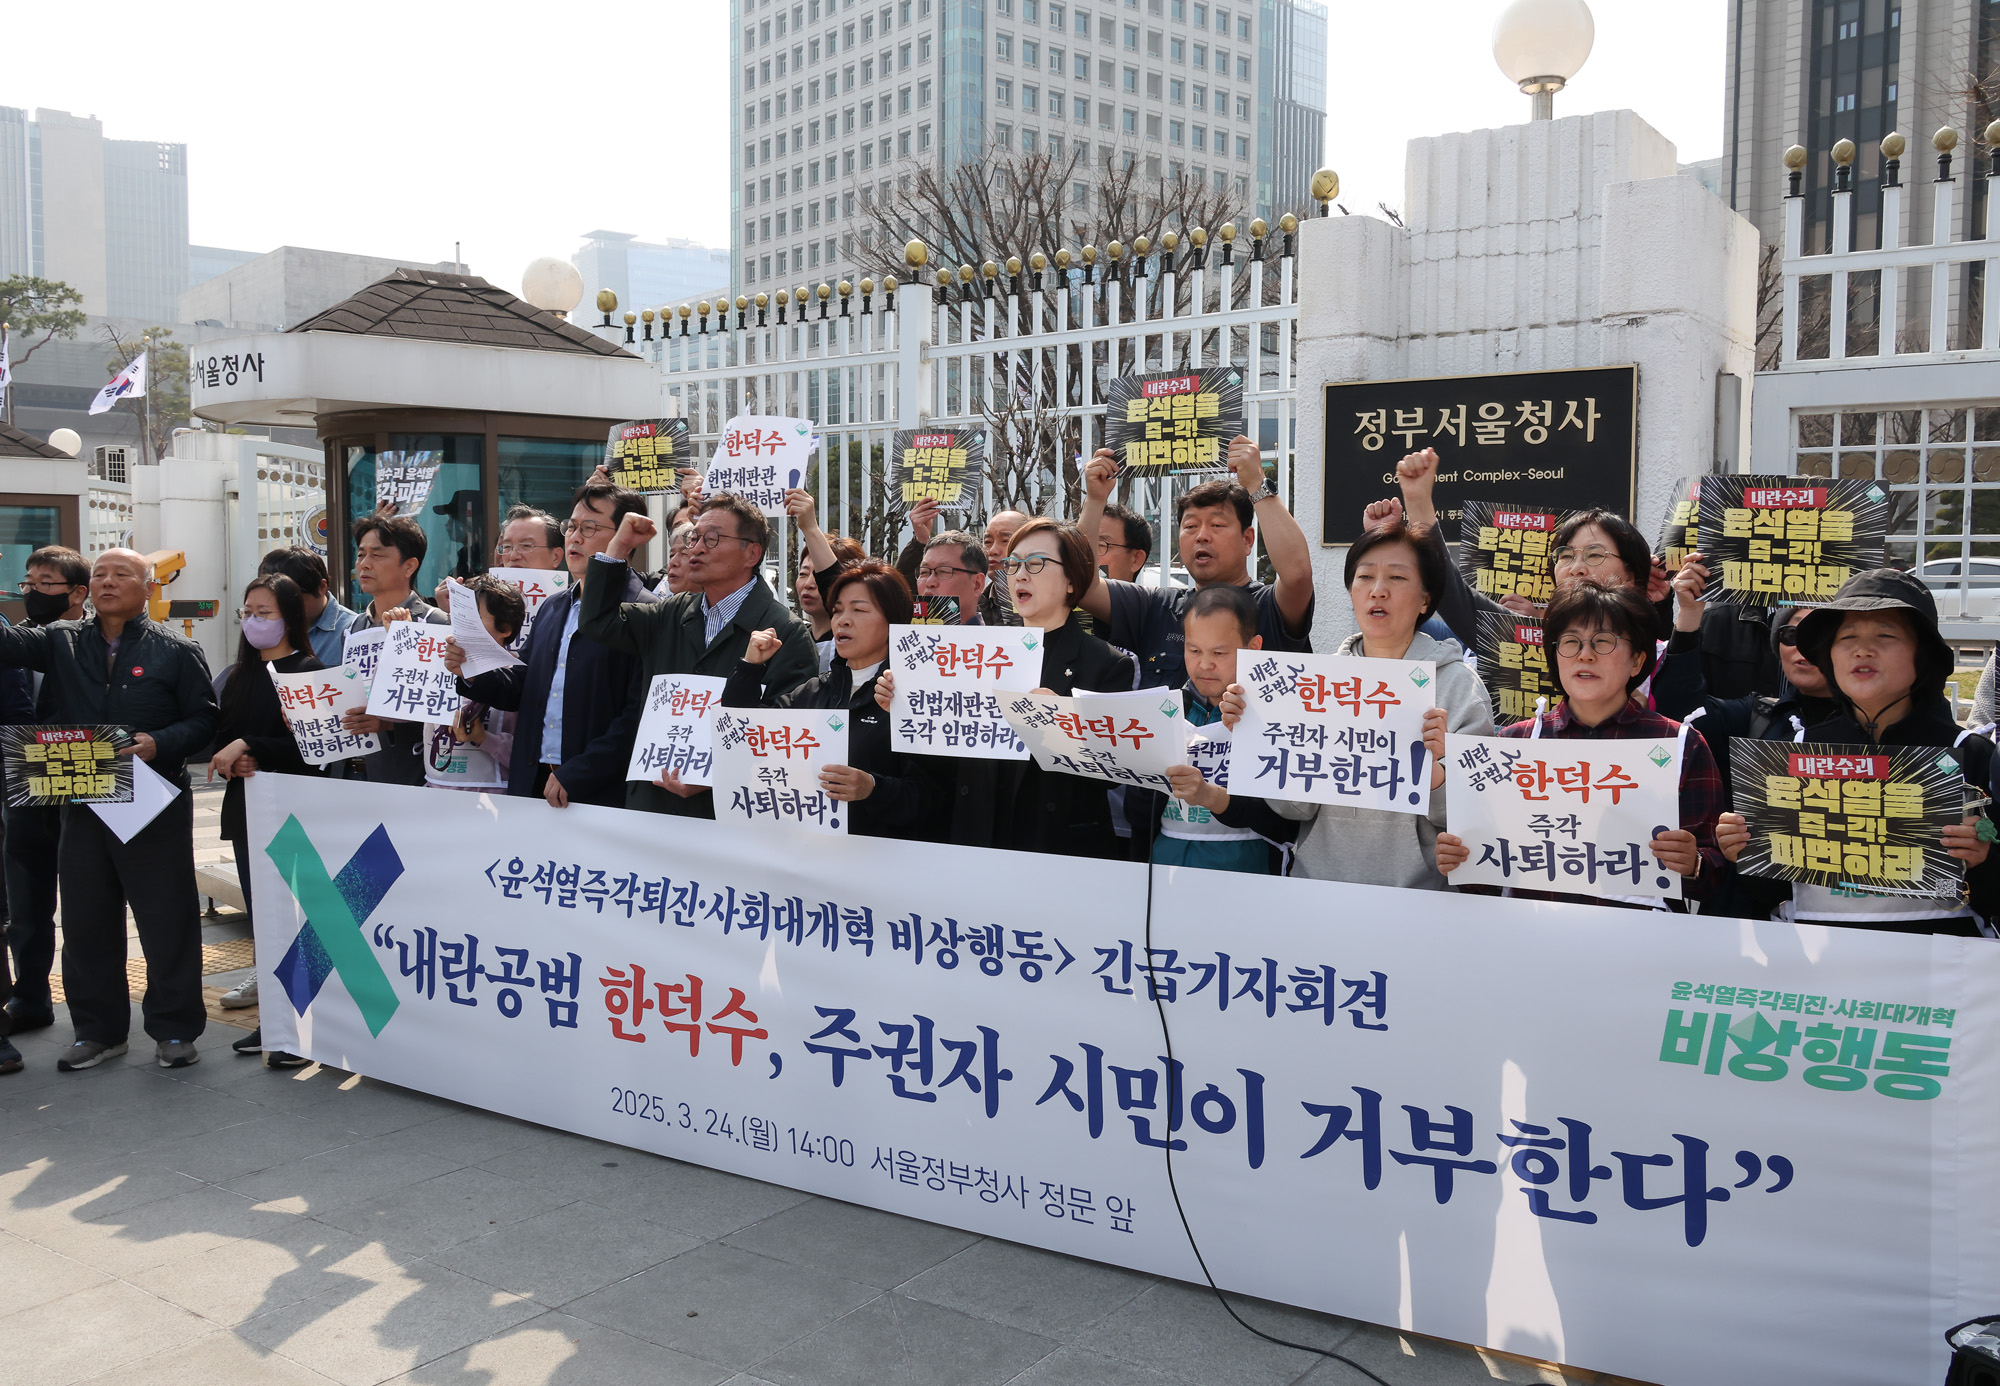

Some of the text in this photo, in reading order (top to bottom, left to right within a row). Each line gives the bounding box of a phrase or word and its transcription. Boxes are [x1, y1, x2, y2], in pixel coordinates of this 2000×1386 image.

[191, 353, 265, 389] 서울청사
[1147, 378, 1191, 395] 내란수괴
[1126, 393, 1220, 423] 윤석열을
[1353, 397, 1601, 451] 정부서울청사
[612, 436, 673, 458] 윤석열을
[726, 428, 787, 457] 한덕수
[1125, 437, 1221, 467] 파면하라
[902, 447, 968, 468] 윤석열을
[612, 468, 676, 489] 파면하라
[708, 465, 777, 489] 헌법재판관
[1463, 467, 1564, 483] Complex-Seoul
[902, 481, 962, 502] 파면하라
[1751, 489, 1814, 506] 내란수괴
[1499, 514, 1545, 528] 내란수괴
[1723, 508, 1854, 541] 윤석열을
[1478, 526, 1557, 556] 윤석열
[1722, 561, 1851, 596] 파면하라
[392, 625, 411, 642] 내란
[394, 637, 414, 655] 공범
[896, 630, 921, 653] 내란
[1520, 628, 1545, 643] 내란
[904, 643, 1013, 680] 공범 한덕수
[1248, 657, 1280, 683] 내란
[1498, 641, 1550, 673] 윤석
[391, 667, 429, 687] 주권자
[651, 679, 668, 697] 내란
[278, 684, 343, 710] 한덕수
[652, 692, 670, 711] 공범
[1009, 697, 1037, 716] 내란
[1258, 674, 1401, 719] 공범 한덕수
[42, 730, 86, 742] 내란수괴
[667, 725, 693, 744] 즉각
[716, 713, 732, 733] 내란
[899, 719, 936, 745] 즉각
[1022, 711, 1155, 750] 공범 한덕수
[24, 741, 115, 762] 윤석열을
[721, 725, 821, 760] 공범 한덕수
[1262, 722, 1396, 756] 주권자 시민이
[1078, 746, 1117, 765] 즉각
[1458, 743, 1492, 770] 내란
[1797, 756, 1874, 776] 내란수괴
[28, 774, 117, 797] 파면하라
[757, 766, 789, 787] 즉각
[1254, 740, 1427, 806] 거부한다!
[1469, 760, 1639, 805] 공범 한덕수
[730, 786, 840, 829] 사퇴하라!
[1765, 775, 1924, 819] 윤석열을
[1527, 813, 1582, 840] 즉각
[1476, 825, 1671, 889] 사퇴하라!
[1768, 832, 1925, 882] 파면하라
[1092, 939, 1390, 1031] 긴급기자회견
[1659, 1008, 1952, 1100] 비상행동
[373, 922, 1794, 1248] “내란공범 한덕수, 주권자 시민이 거부한다”
[611, 1086, 671, 1127] 2025.
[678, 1102, 698, 1133] 3.
[787, 1127, 855, 1167] 14:00
[870, 1146, 1030, 1210] 서울정부청사
[1038, 1181, 1097, 1225] 정문
[1105, 1195, 1137, 1234] 앞
